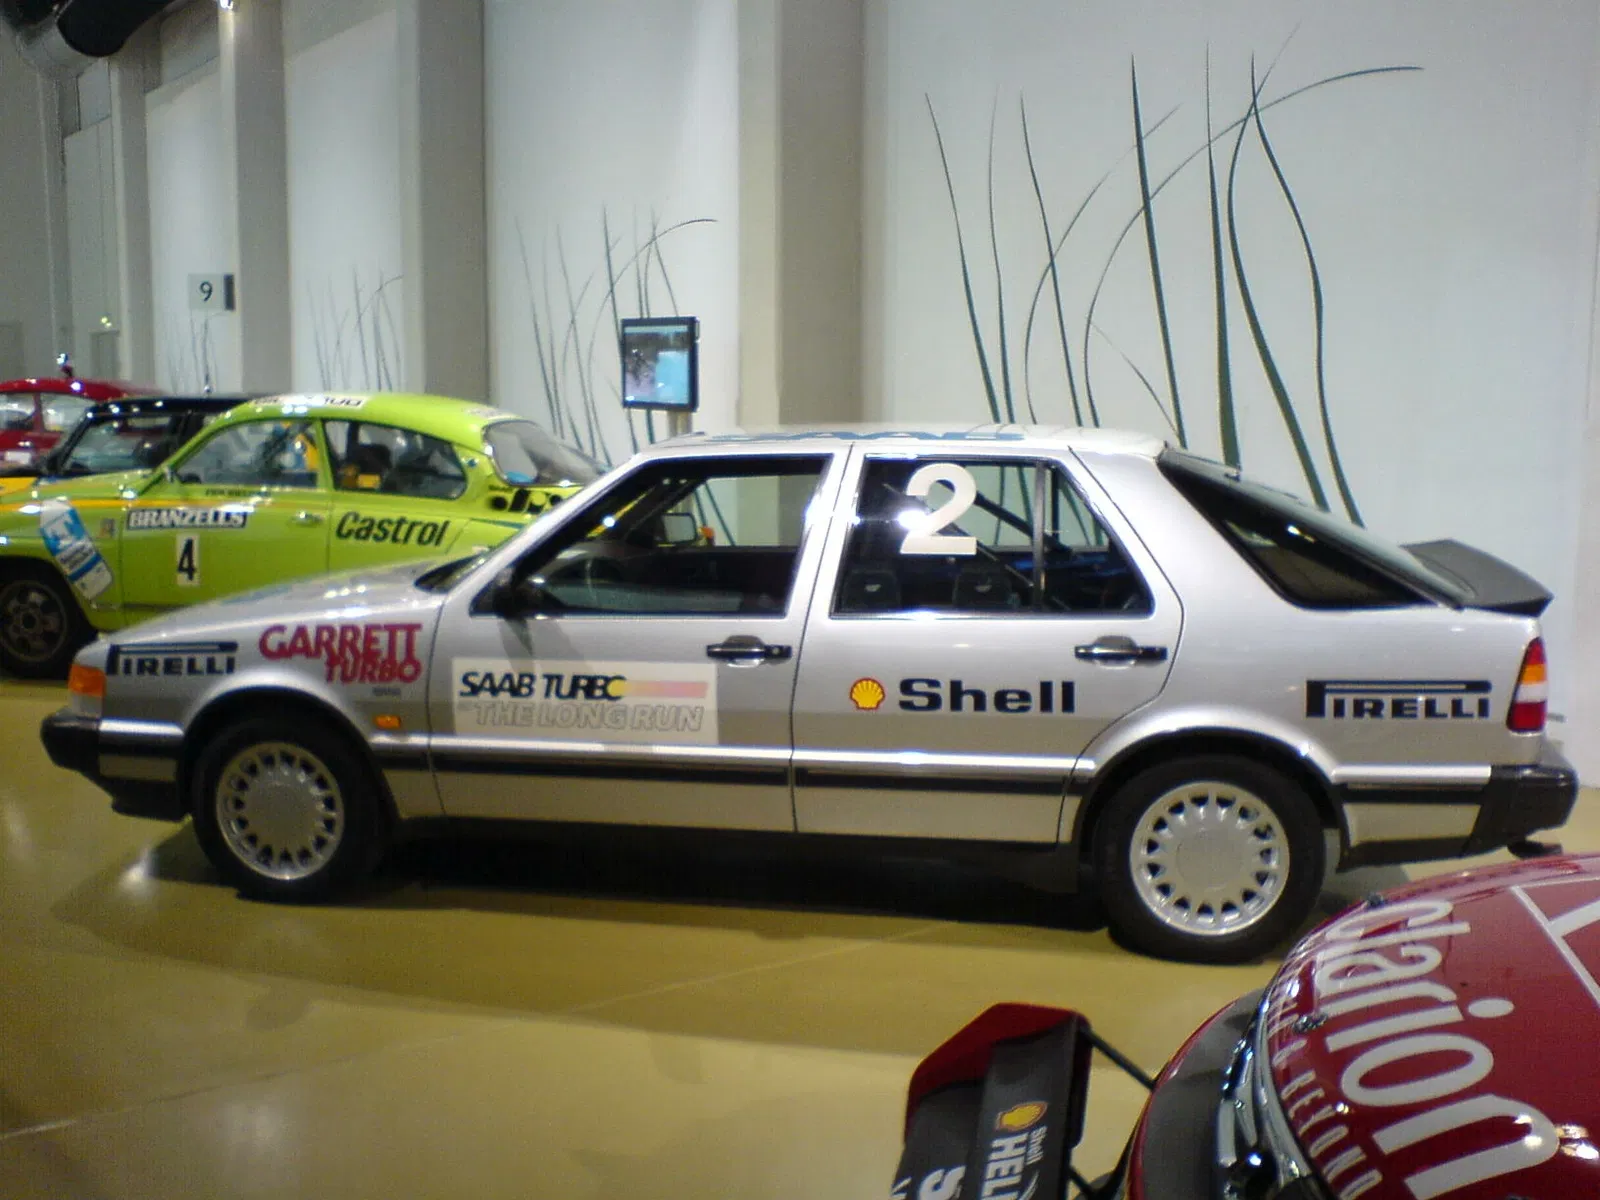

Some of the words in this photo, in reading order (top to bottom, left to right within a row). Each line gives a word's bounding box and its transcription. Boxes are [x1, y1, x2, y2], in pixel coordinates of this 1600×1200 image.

[199, 280, 213, 302] 9
[899, 462, 977, 555] 2
[335, 511, 450, 547] Castrol
[177, 538, 196, 581] 4
[105, 641, 238, 675] PIRELLI
[258, 623, 423, 660] GARRETT
[323, 650, 422, 684] TURBO
[459, 671, 535, 699] SAAB
[898, 677, 1076, 714] Shell
[1305, 679, 1493, 718] PIRELLI
[474, 702, 534, 727] THE
[539, 703, 628, 730] LONG
[629, 706, 705, 732] RUN
[1312, 898, 1560, 1200] clarion
